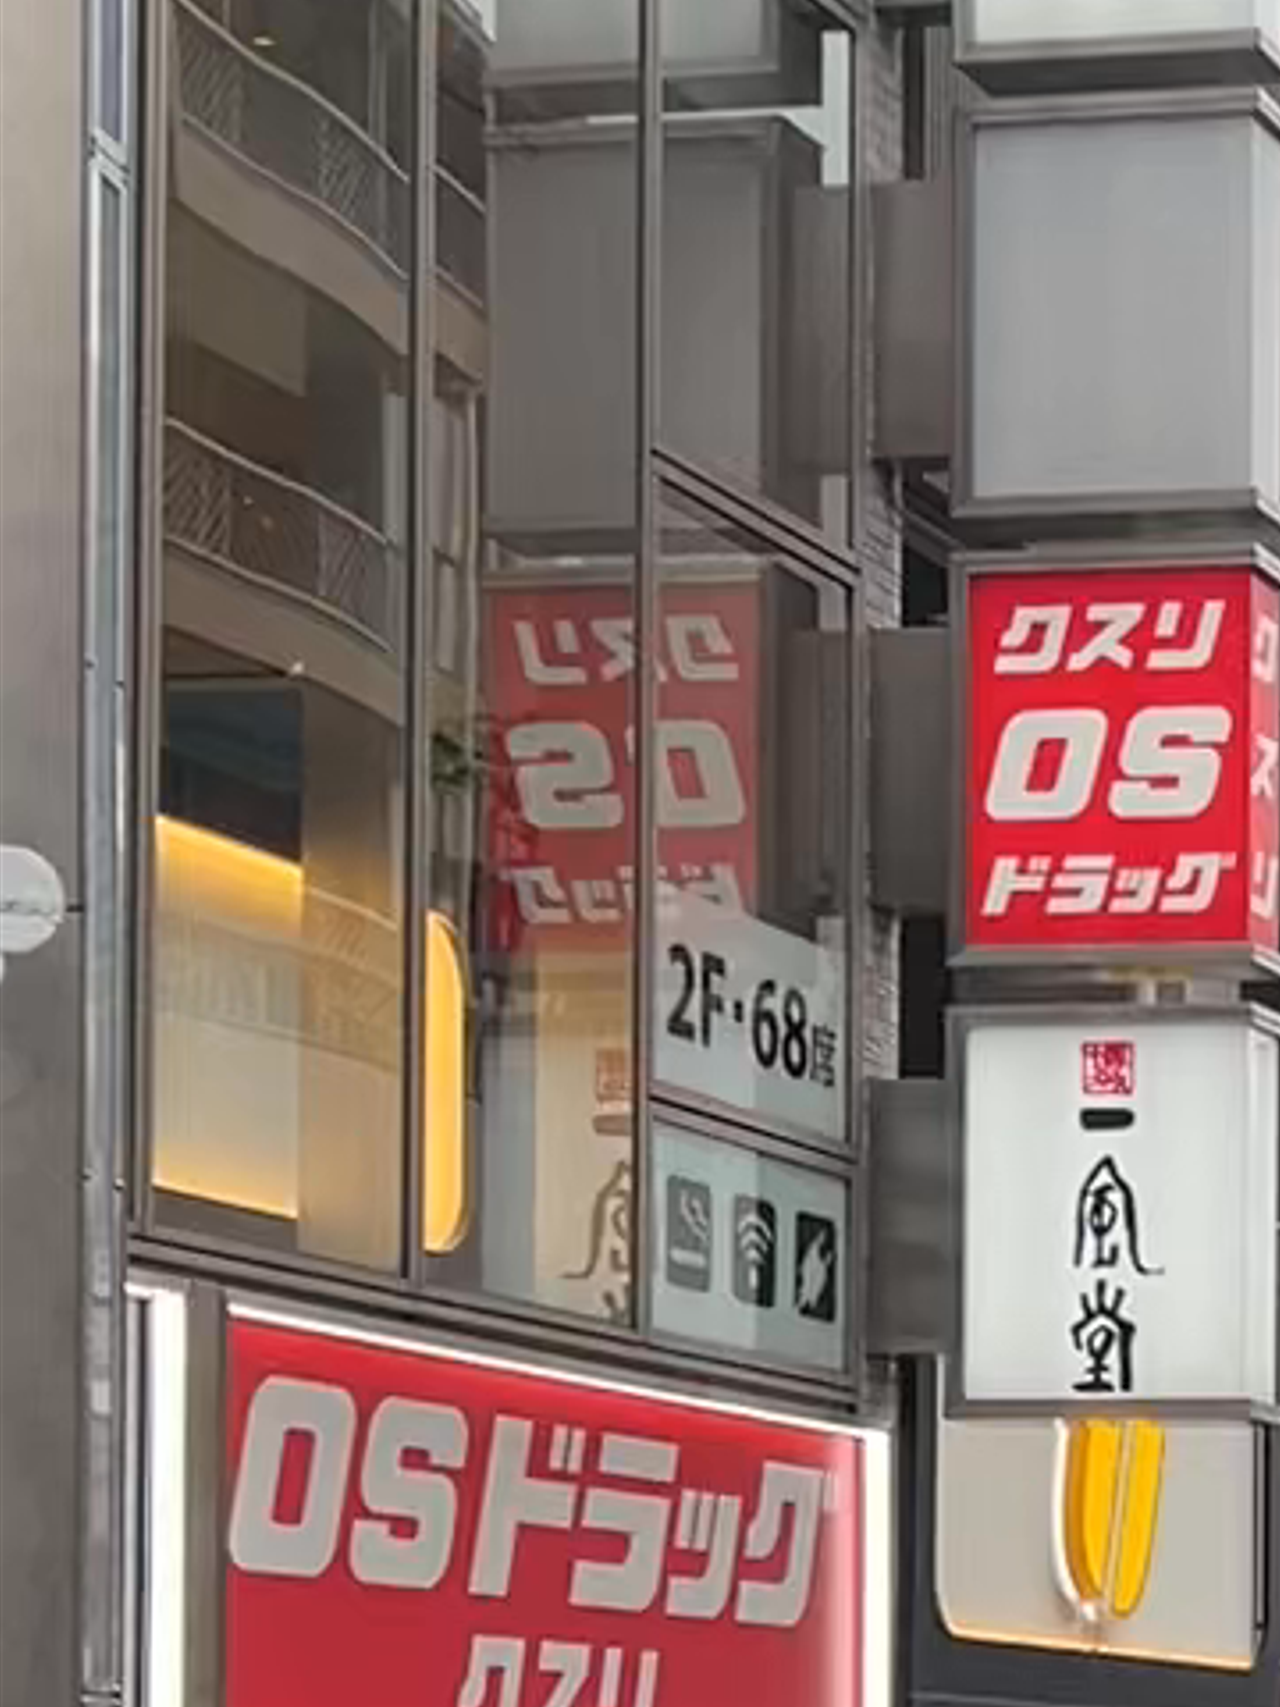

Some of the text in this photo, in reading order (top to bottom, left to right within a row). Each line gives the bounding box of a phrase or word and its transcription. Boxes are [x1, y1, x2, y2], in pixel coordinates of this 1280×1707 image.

[994, 598, 1225, 675] クスリ
[982, 705, 1234, 821] OS
[980, 851, 1237, 918] ドラッグ
[1069, 1105, 1166, 1394] 一風堂
[228, 1373, 834, 1628] OSドラッグ
